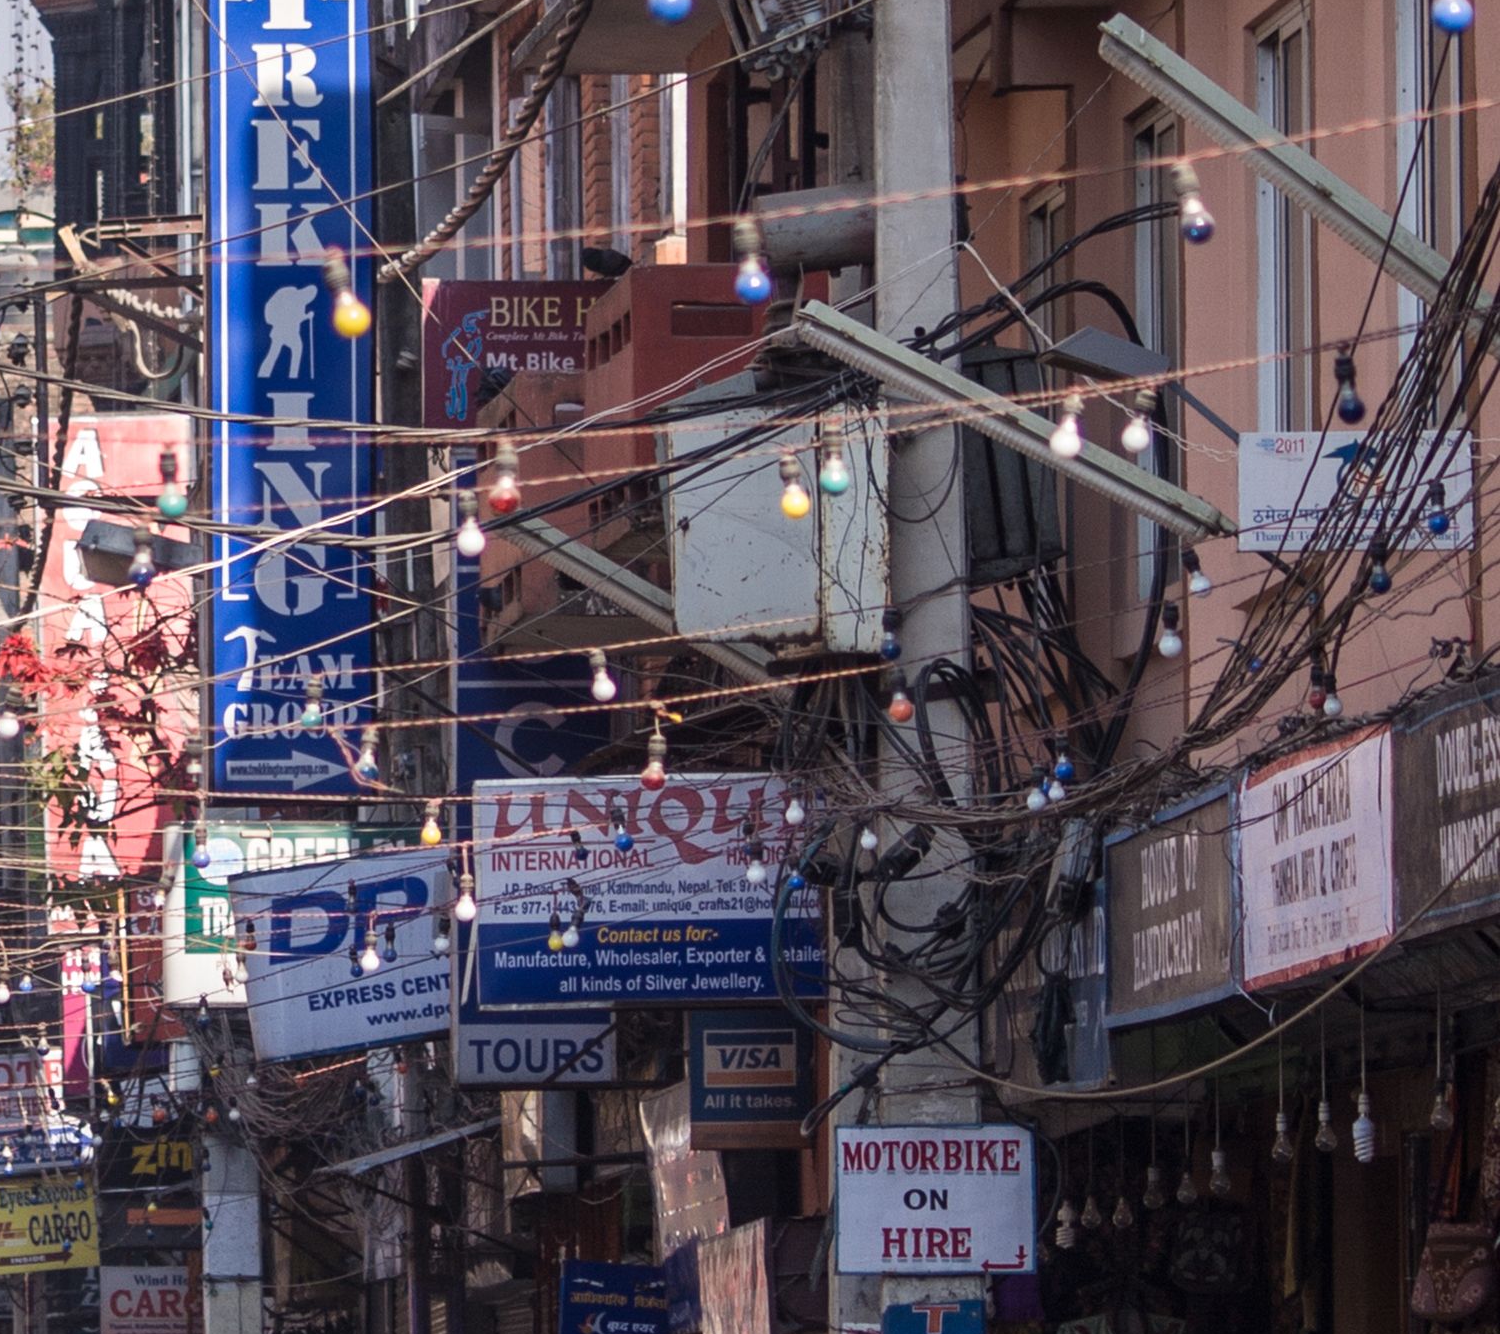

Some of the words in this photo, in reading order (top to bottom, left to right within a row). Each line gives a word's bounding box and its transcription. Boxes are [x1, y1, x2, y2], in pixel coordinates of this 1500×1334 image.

[489, 296, 563, 328] BIKE
[485, 352, 576, 372] Mt.Bike
[1274, 437, 1305, 455] 2011
[1252, 531, 1295, 542] Thamel
[223, 625, 356, 692] TEAM
[491, 848, 655, 872] INTERNATIONAL
[1140, 835, 1178, 910] HOUSE
[1183, 828, 1199, 893] OF
[501, 883, 522, 897] J.P.
[607, 880, 675, 898] Kathmandu,
[678, 879, 712, 897] Nepal.
[716, 878, 736, 893] Tel:
[494, 901, 519, 916] Fax:
[608, 899, 649, 914] E-mail:
[597, 926, 659, 944] Contact
[661, 929, 681, 943] us
[494, 951, 592, 969] Manufacture,
[595, 949, 682, 967] Wholesaler,
[686, 949, 752, 967] Exporter
[754, 948, 766, 963] &
[777, 947, 827, 963] etailer
[1132, 907, 1202, 992] HANDICRAFT
[307, 981, 396, 1012] EXPRESS
[401, 973, 451, 997] CENT
[559, 977, 577, 993] all
[581, 975, 623, 992] kinds
[626, 975, 642, 991] of
[645, 974, 688, 991] Silver
[691, 973, 765, 993] Jewellery.
[467, 1037, 606, 1075] TOURS
[715, 1047, 782, 1070] VISA
[703, 1093, 725, 1109] All
[730, 1093, 742, 1108] it
[745, 1092, 797, 1108] takes.
[841, 1138, 1022, 1173] MOTORBIKE
[902, 1188, 949, 1212] ON
[28, 1209, 92, 1247] CARGO
[881, 1227, 973, 1260] HIRE
[10, 1254, 47, 1265] INSIDE
[133, 1274, 168, 1287] Wind
